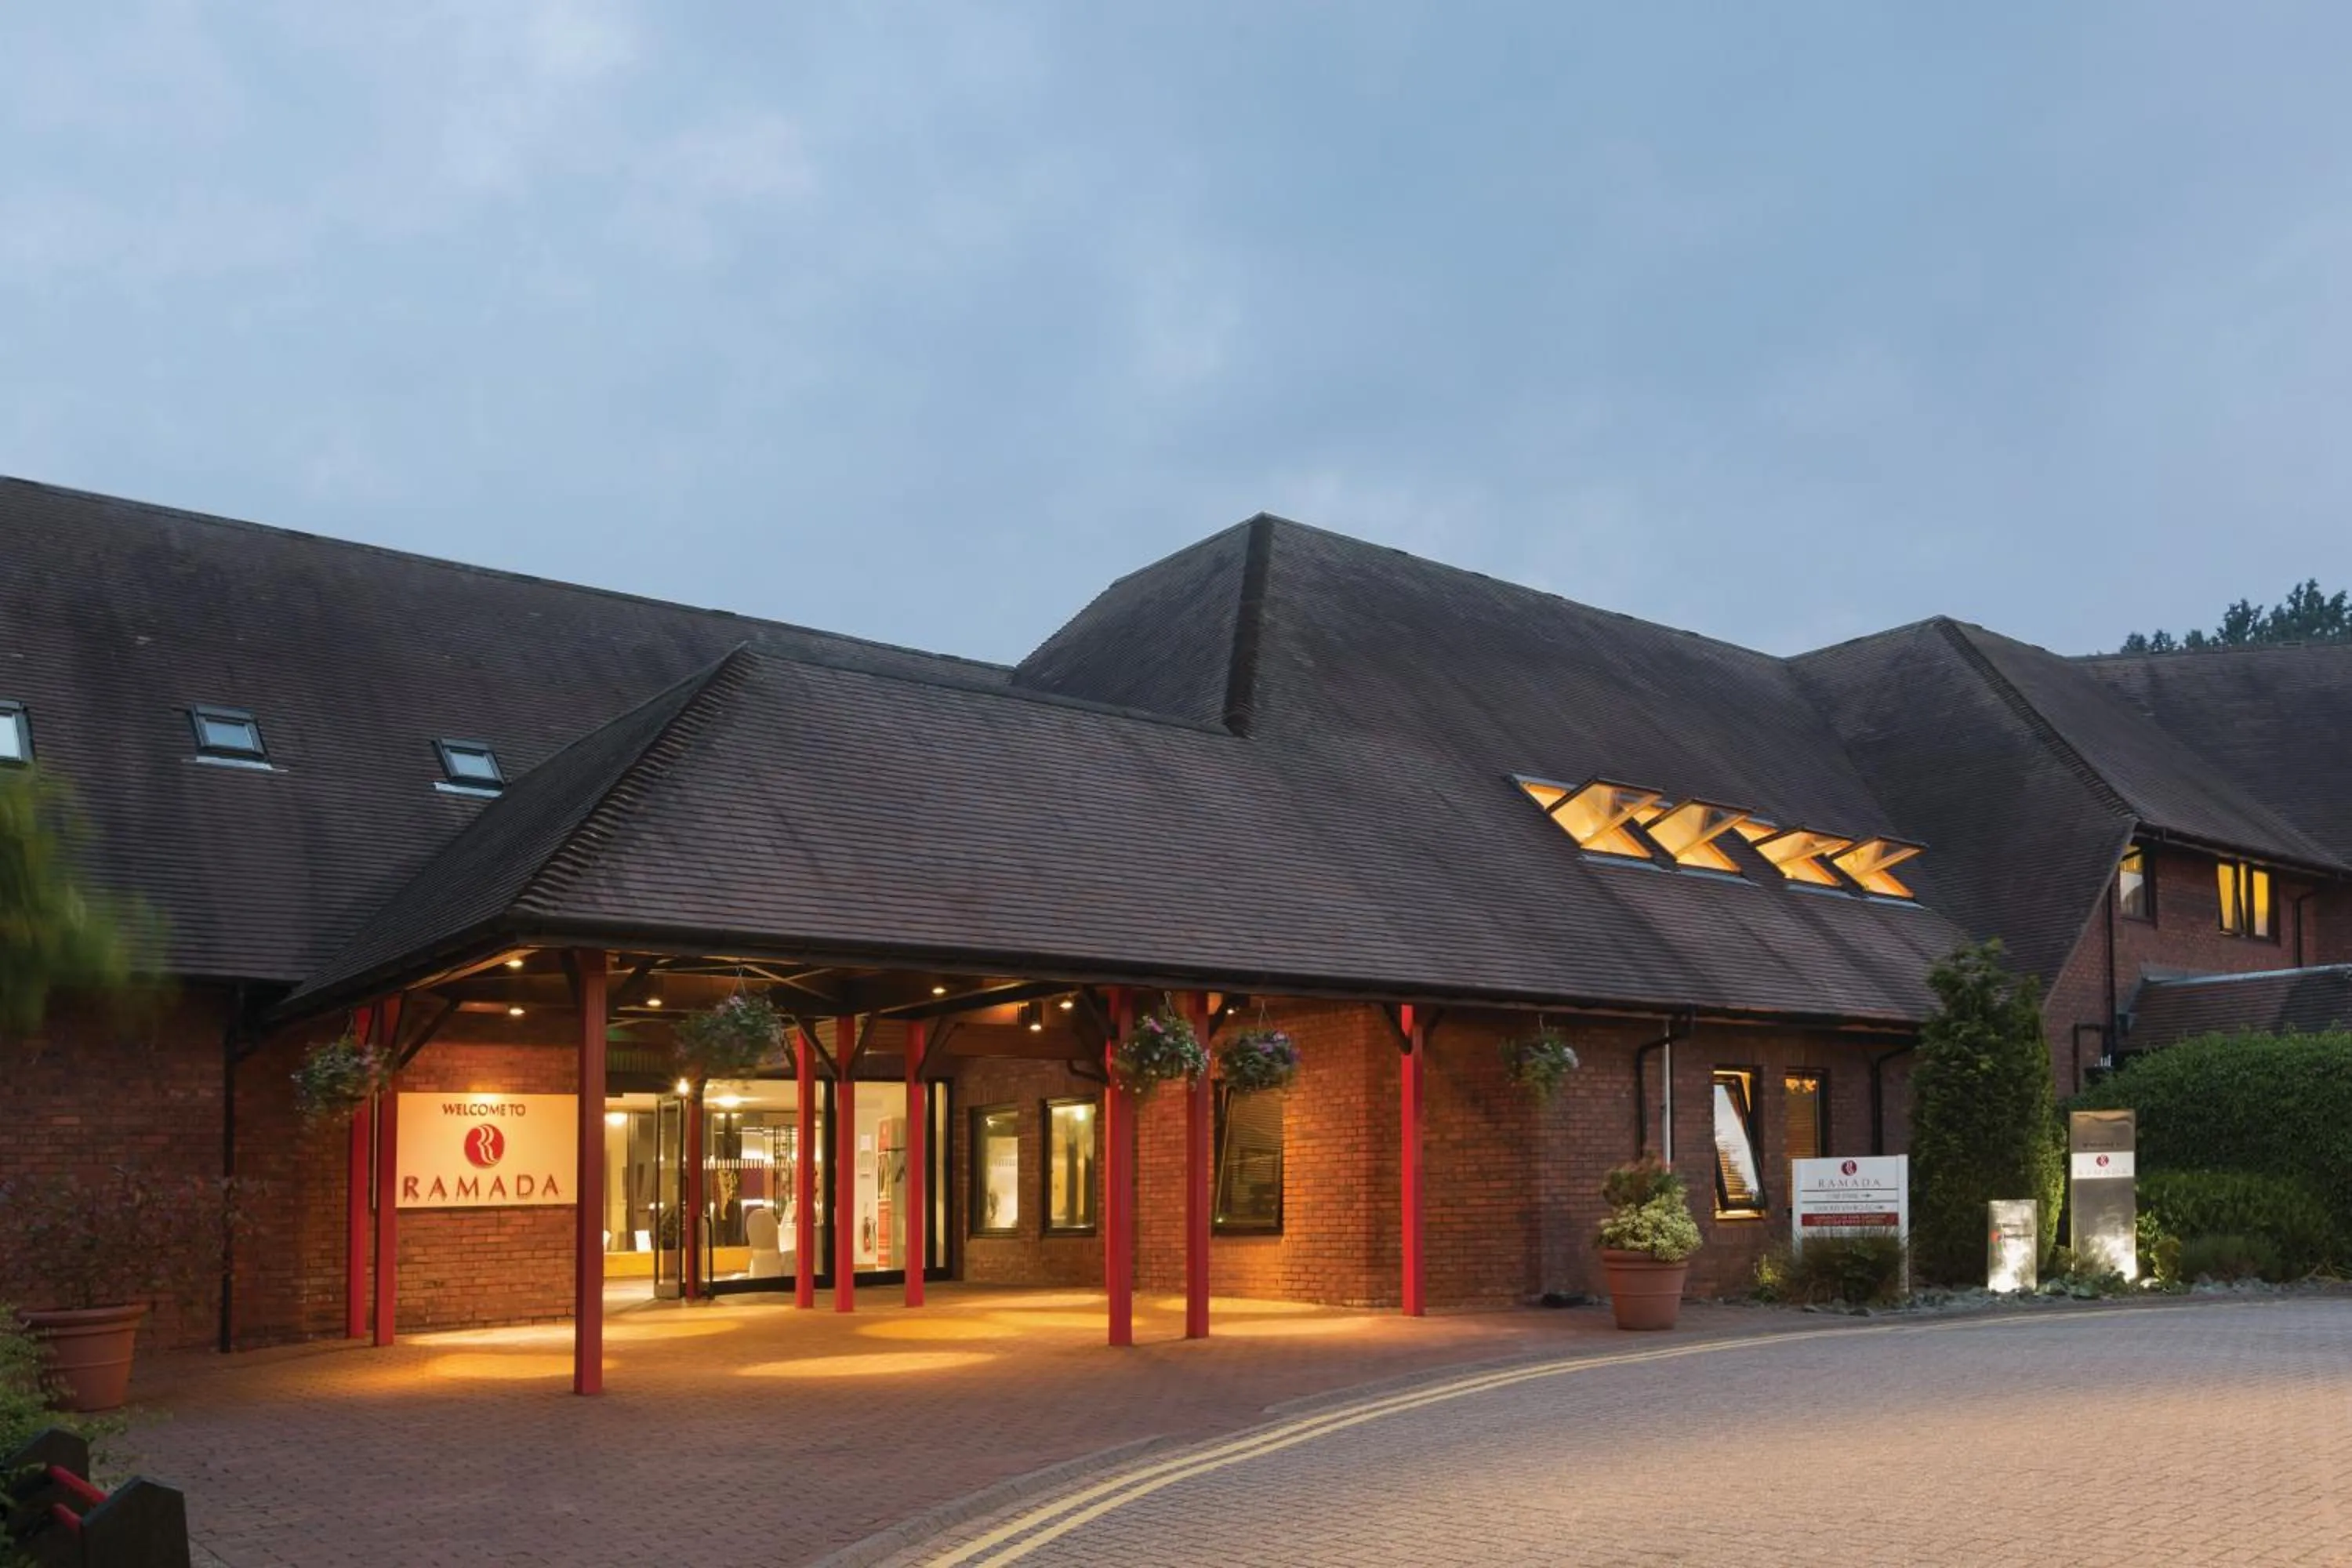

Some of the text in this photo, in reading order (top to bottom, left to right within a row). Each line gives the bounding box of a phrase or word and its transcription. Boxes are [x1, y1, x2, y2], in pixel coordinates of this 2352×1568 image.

[442, 1103, 526, 1116] WELCOME TO
[402, 1174, 560, 1202] RAMADA
[1818, 1178, 1881, 1188] RAMADA
